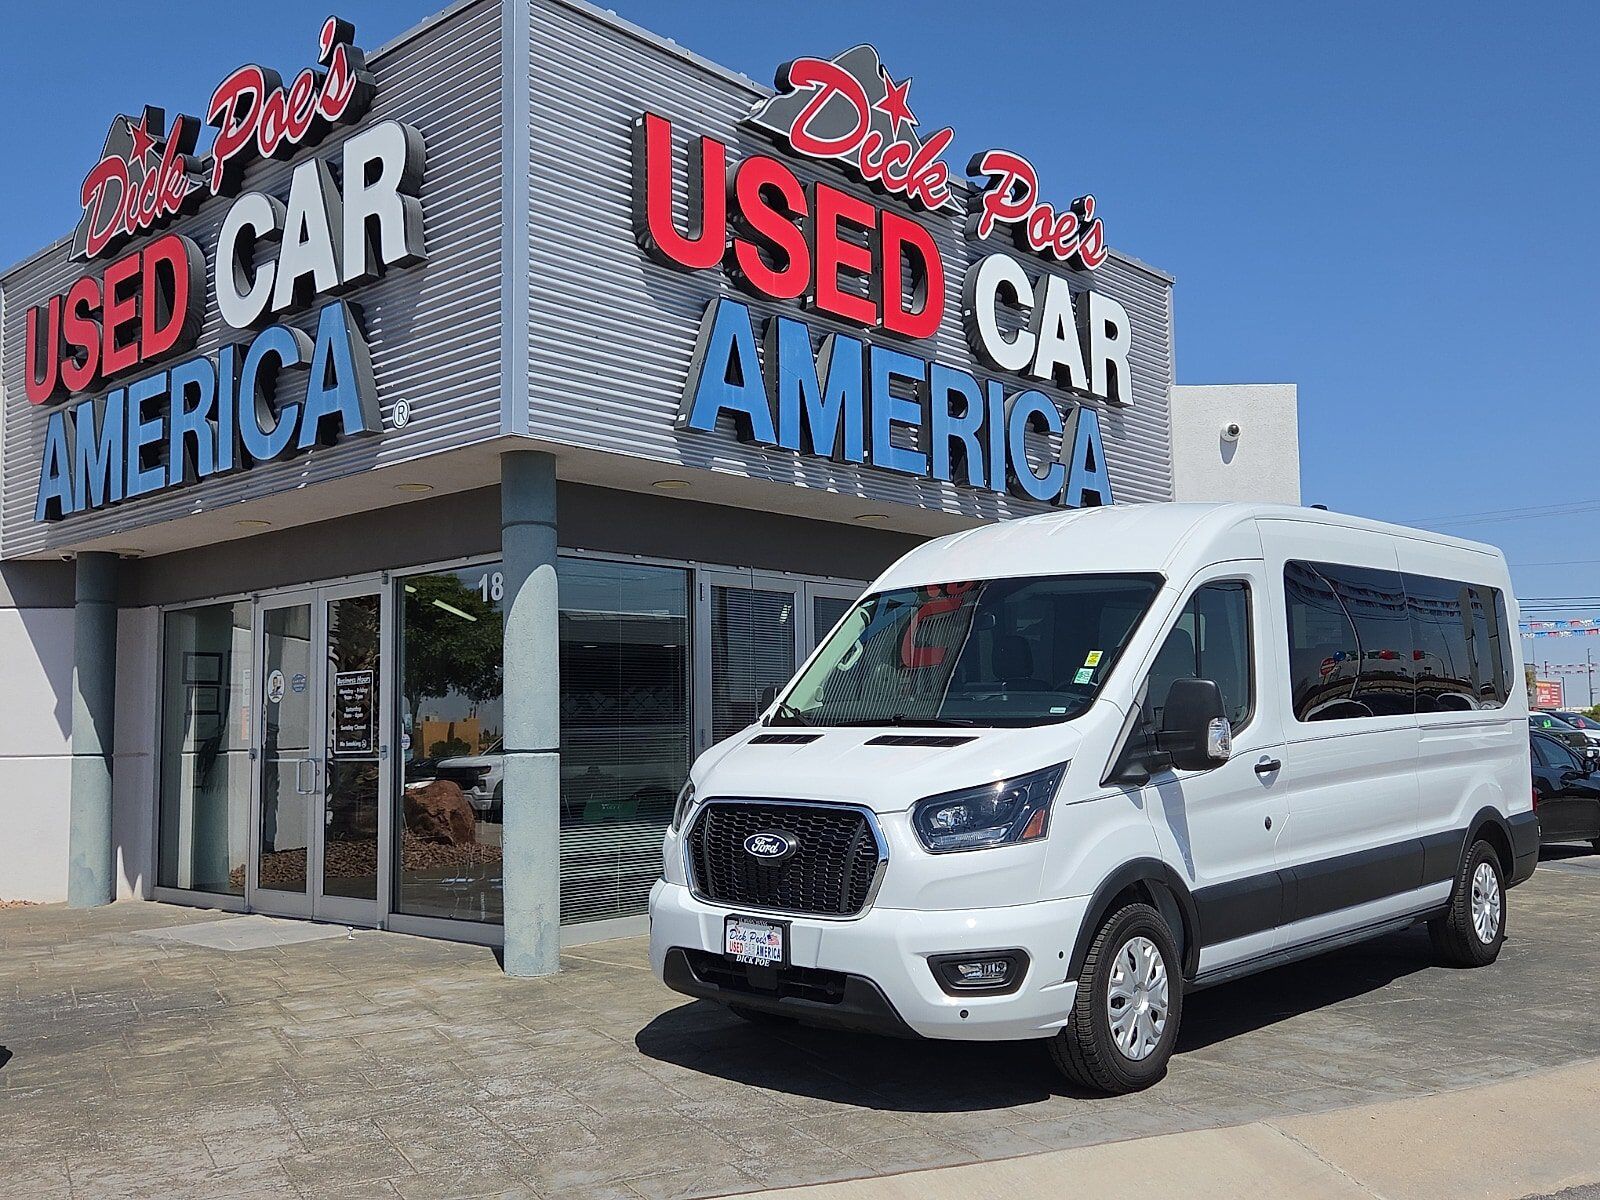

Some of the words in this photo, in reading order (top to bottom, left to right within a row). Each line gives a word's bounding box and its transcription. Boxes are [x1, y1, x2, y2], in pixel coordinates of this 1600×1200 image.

[80, 112, 190, 259] Dick
[206, 15, 357, 195] Poe's
[788, 56, 955, 210] Dick
[978, 149, 1110, 270] Poe's
[25, 234, 190, 405] USED
[214, 119, 412, 329] CAR
[645, 112, 945, 340] USED
[975, 253, 1134, 407] CAR
[34, 299, 366, 523] AMERICA
[688, 297, 1116, 507] AMERICA
[729, 928, 747, 942] Dick
[729, 941, 743, 953] USED
[756, 945, 781, 960] AMERICA
[751, 836, 780, 854] Ford
[736, 954, 754, 965] DICK
[754, 956, 770, 967] POE
